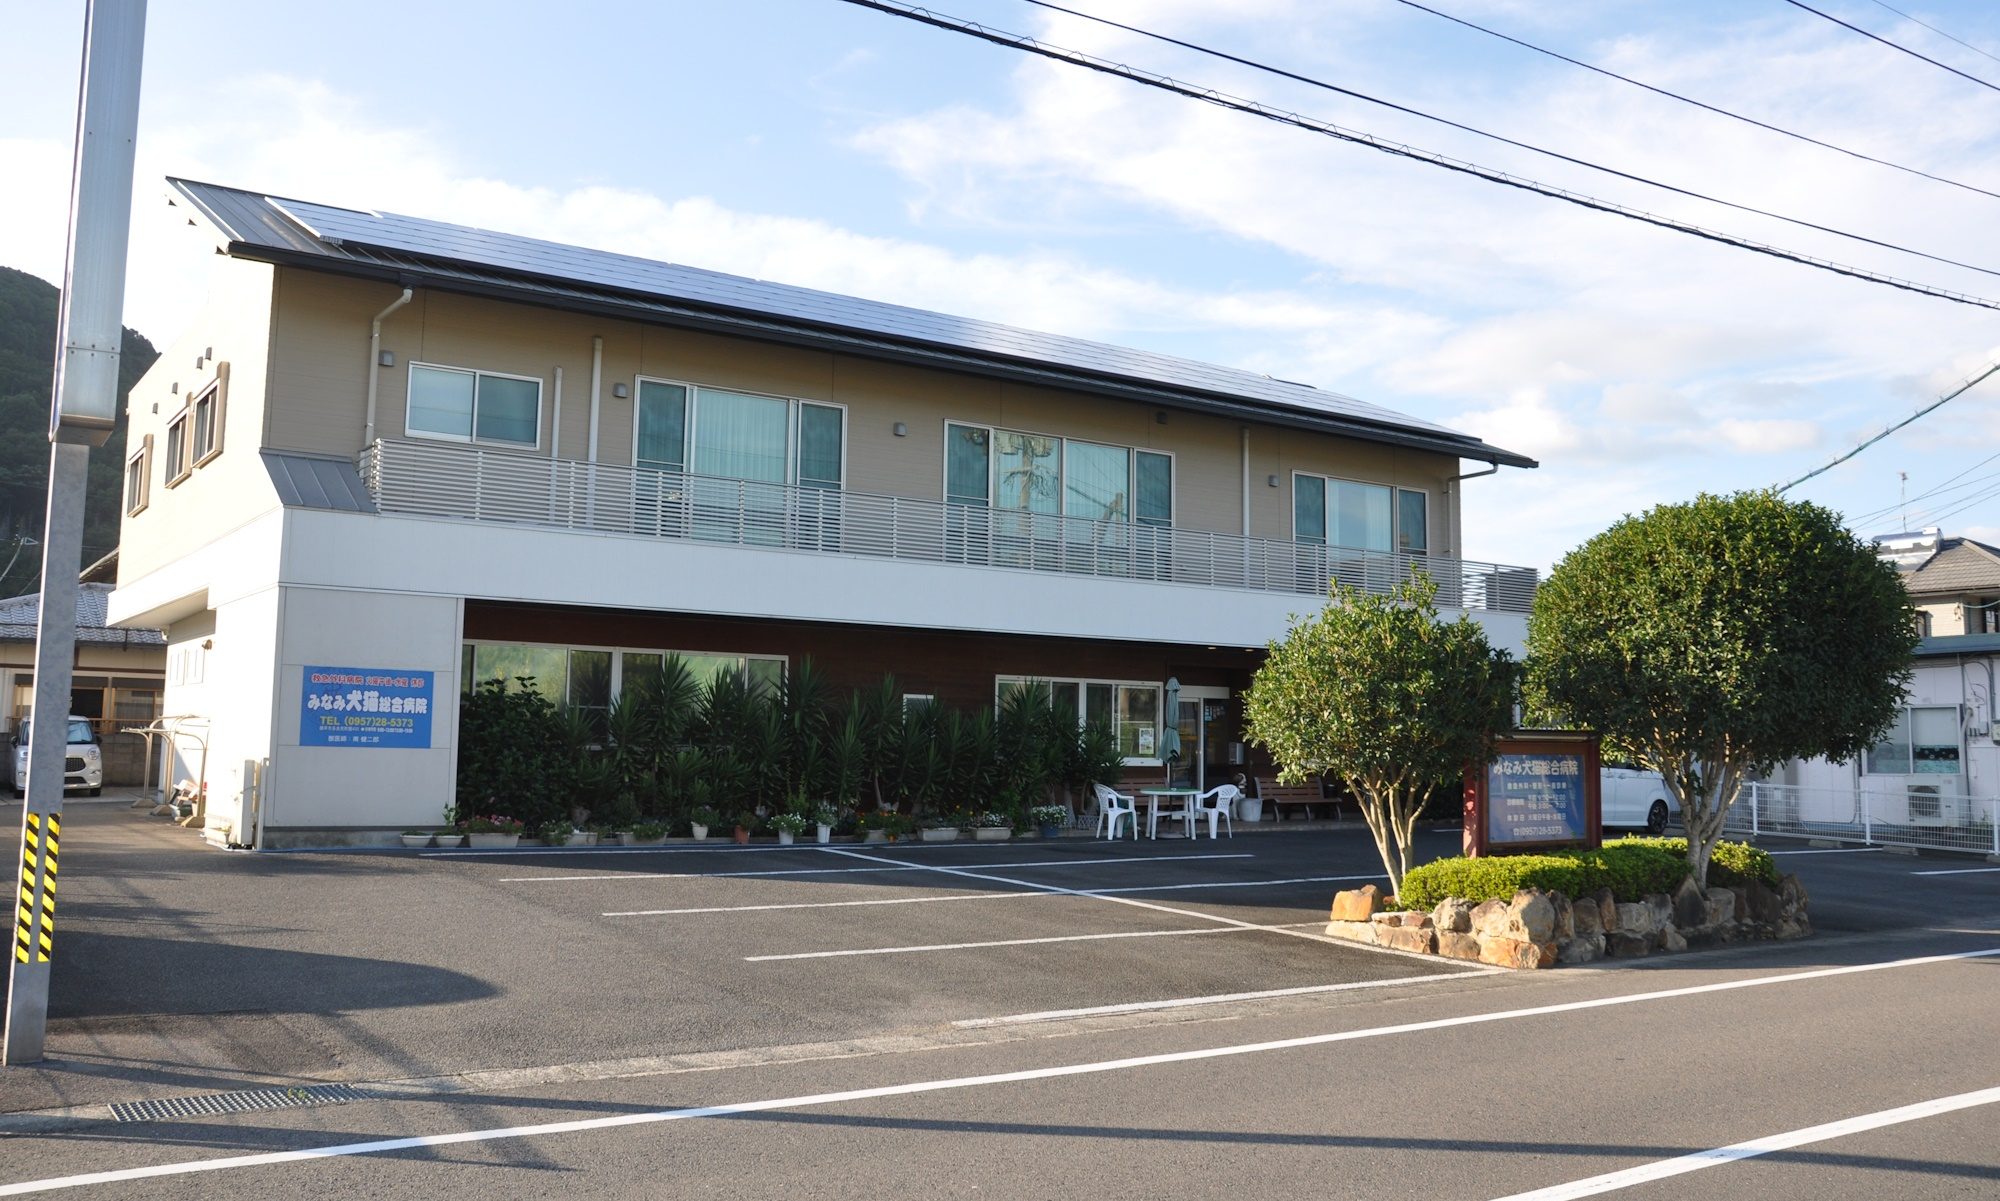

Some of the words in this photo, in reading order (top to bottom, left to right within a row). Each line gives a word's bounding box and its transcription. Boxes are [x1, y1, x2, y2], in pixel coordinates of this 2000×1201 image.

[307, 689, 428, 714] みなみ犬猫総合病院
[320, 716, 340, 726] TEL
[344, 716, 414, 727] (0957)28-5373
[1493, 760, 1578, 776] みなみ犬猫総合病院
